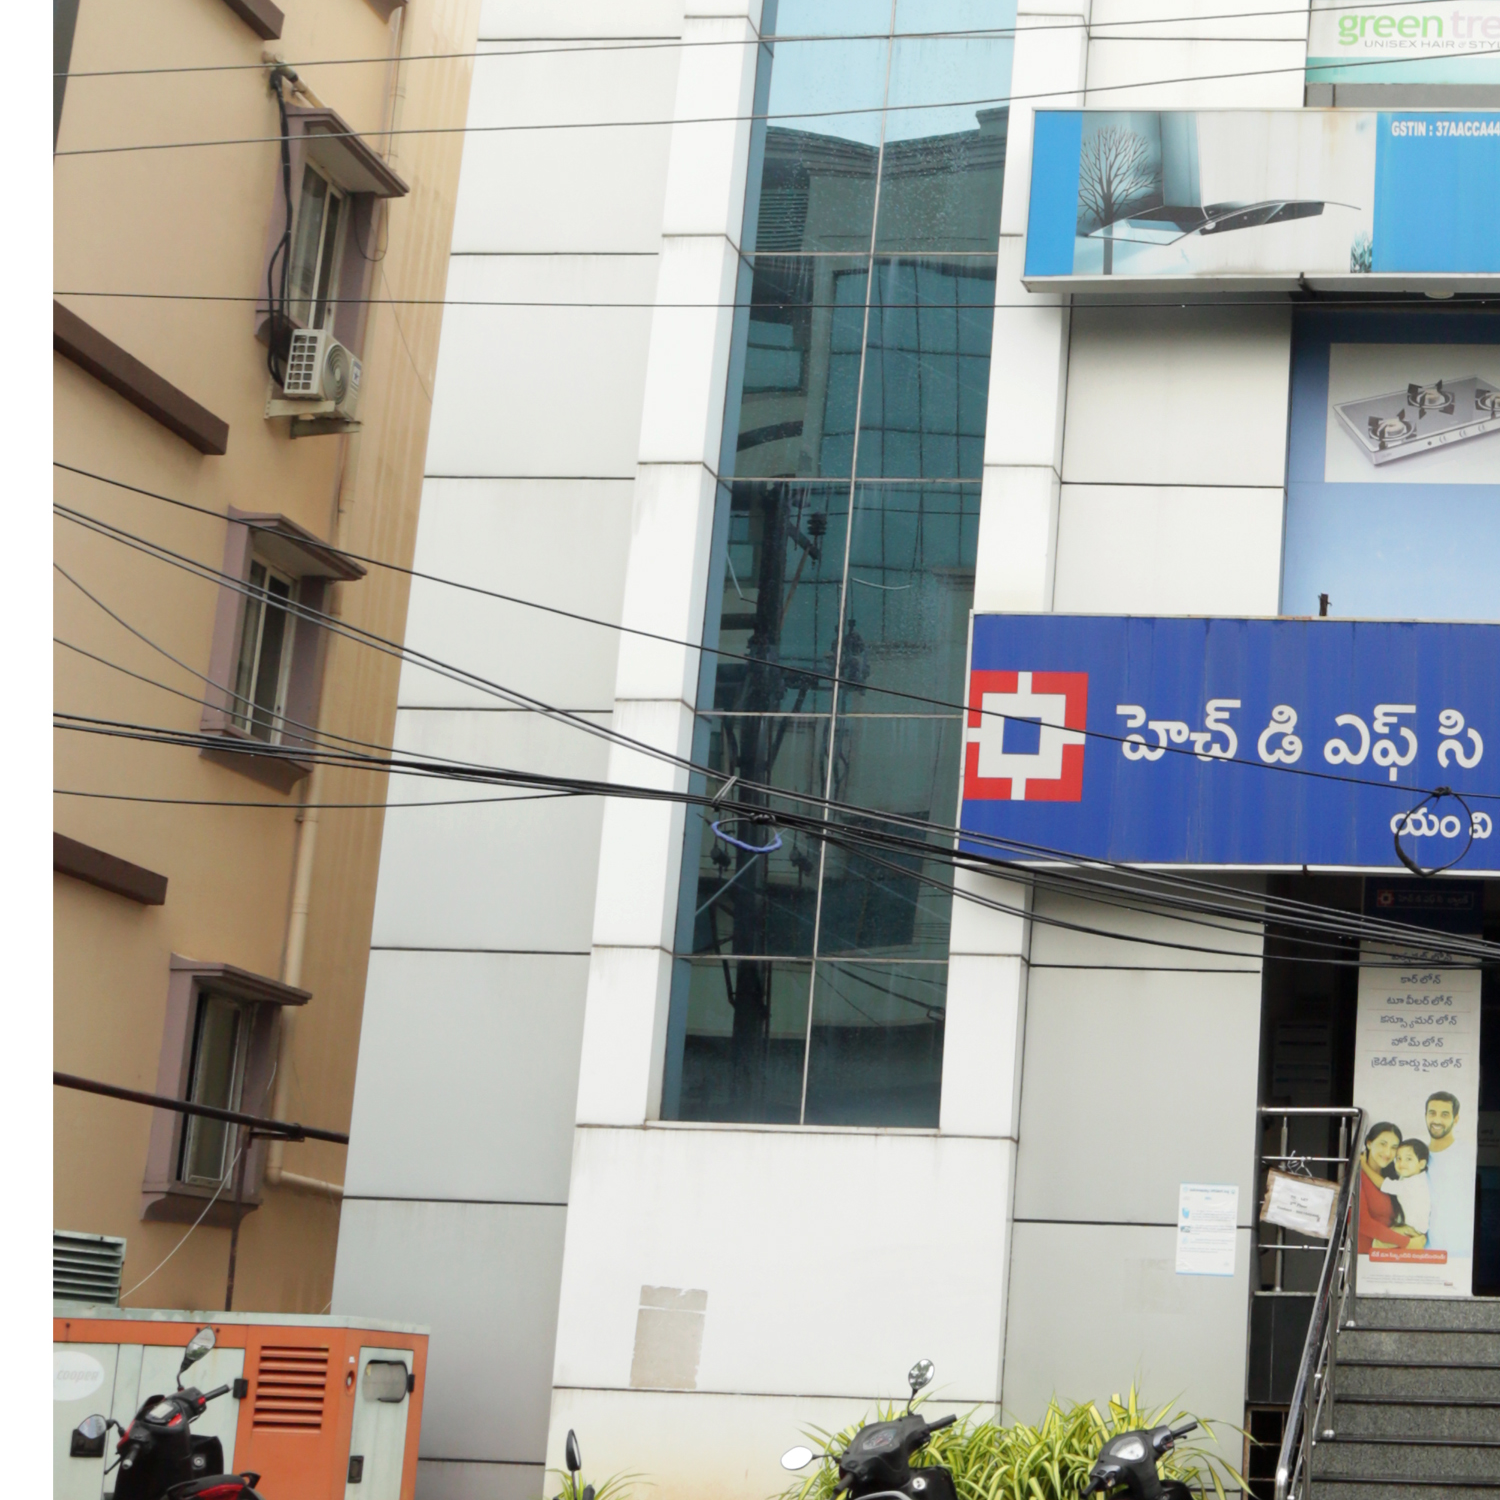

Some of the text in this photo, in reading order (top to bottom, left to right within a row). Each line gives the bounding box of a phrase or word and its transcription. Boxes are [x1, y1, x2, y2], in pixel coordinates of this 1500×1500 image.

[1338, 14, 1443, 46] green
[1364, 40, 1417, 49] UNISEX
[1421, 40, 1455, 49] HAIR
[1391, 121, 1426, 137] GSTIN
[1115, 699, 1242, 762] హెచ్
[1257, 704, 1303, 764] డి
[1437, 709, 1484, 768] సి
